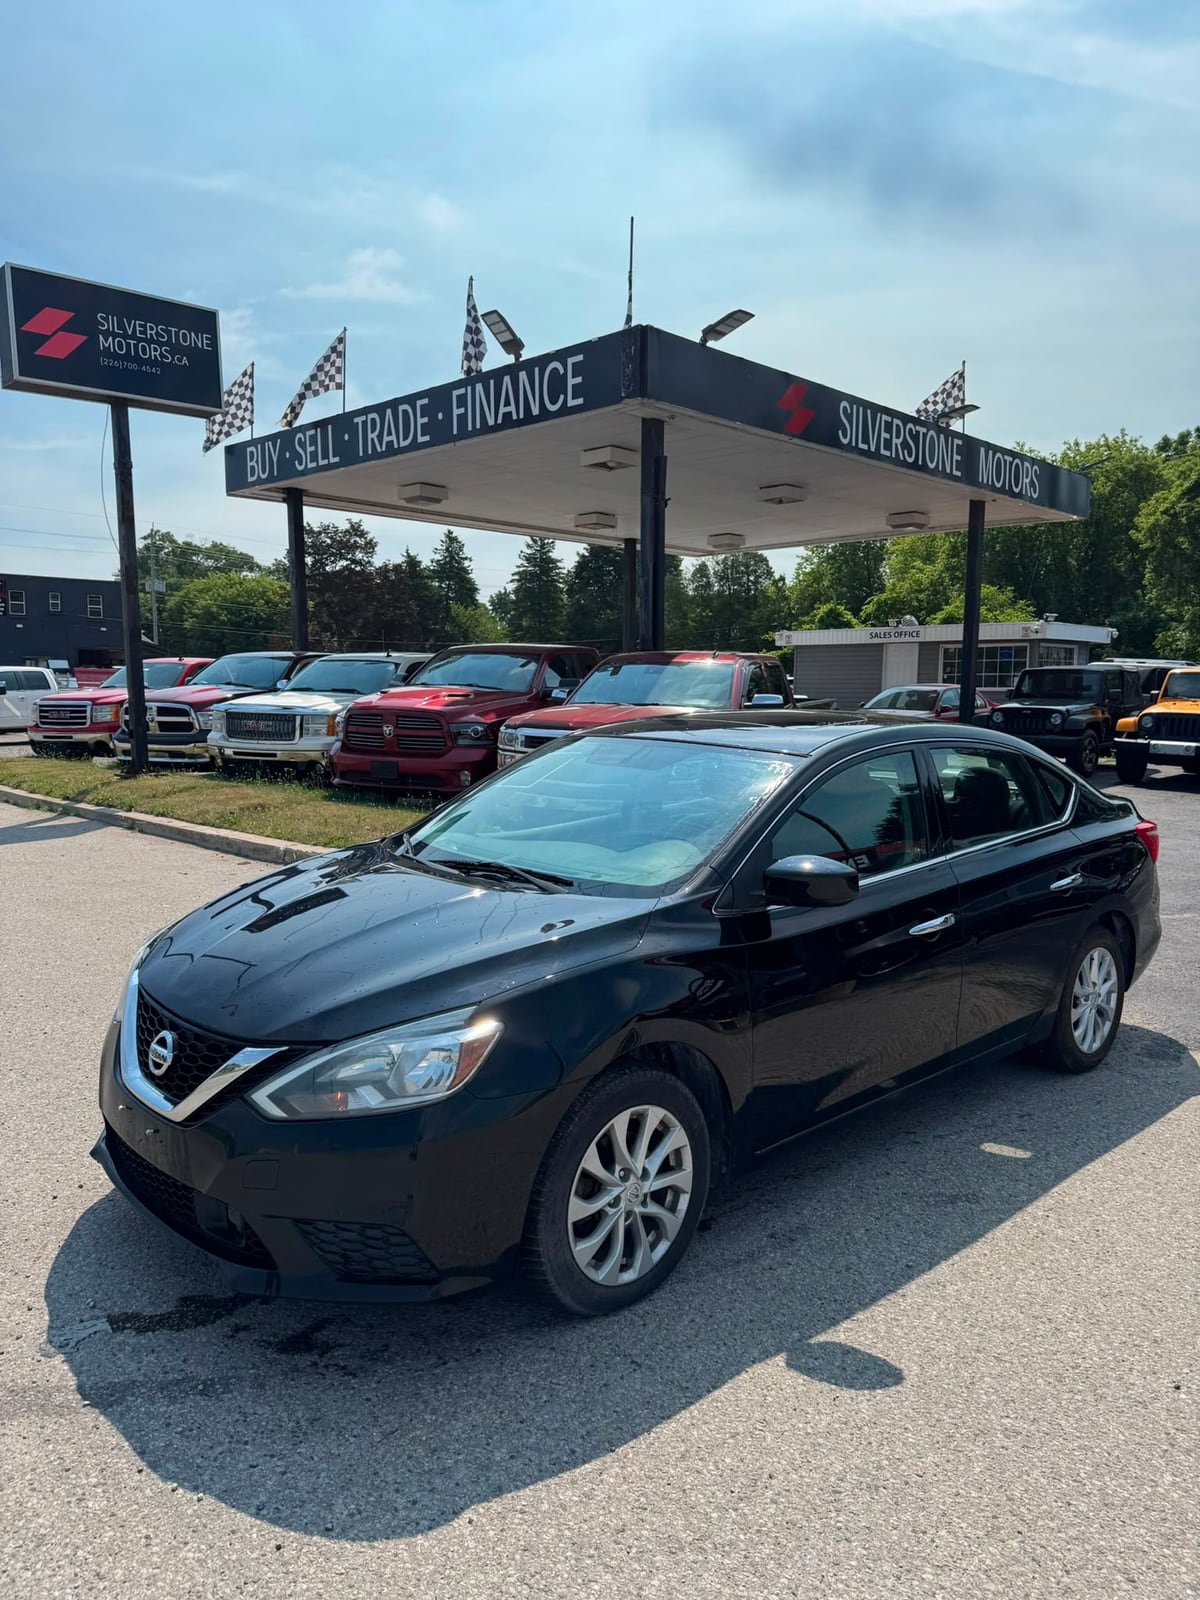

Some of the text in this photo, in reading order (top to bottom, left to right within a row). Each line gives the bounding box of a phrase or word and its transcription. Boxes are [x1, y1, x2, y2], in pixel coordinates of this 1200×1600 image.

[97, 312, 212, 351] SILVERSTONE
[99, 334, 189, 367] MOTORS.CA
[100, 356, 161, 375] (226)700-4542
[247, 354, 584, 483] BUY SELL TRADE FINANCE
[838, 400, 1040, 499] SILVERSTONE MOTORS
[869, 630, 921, 640] SALES OFFICE
